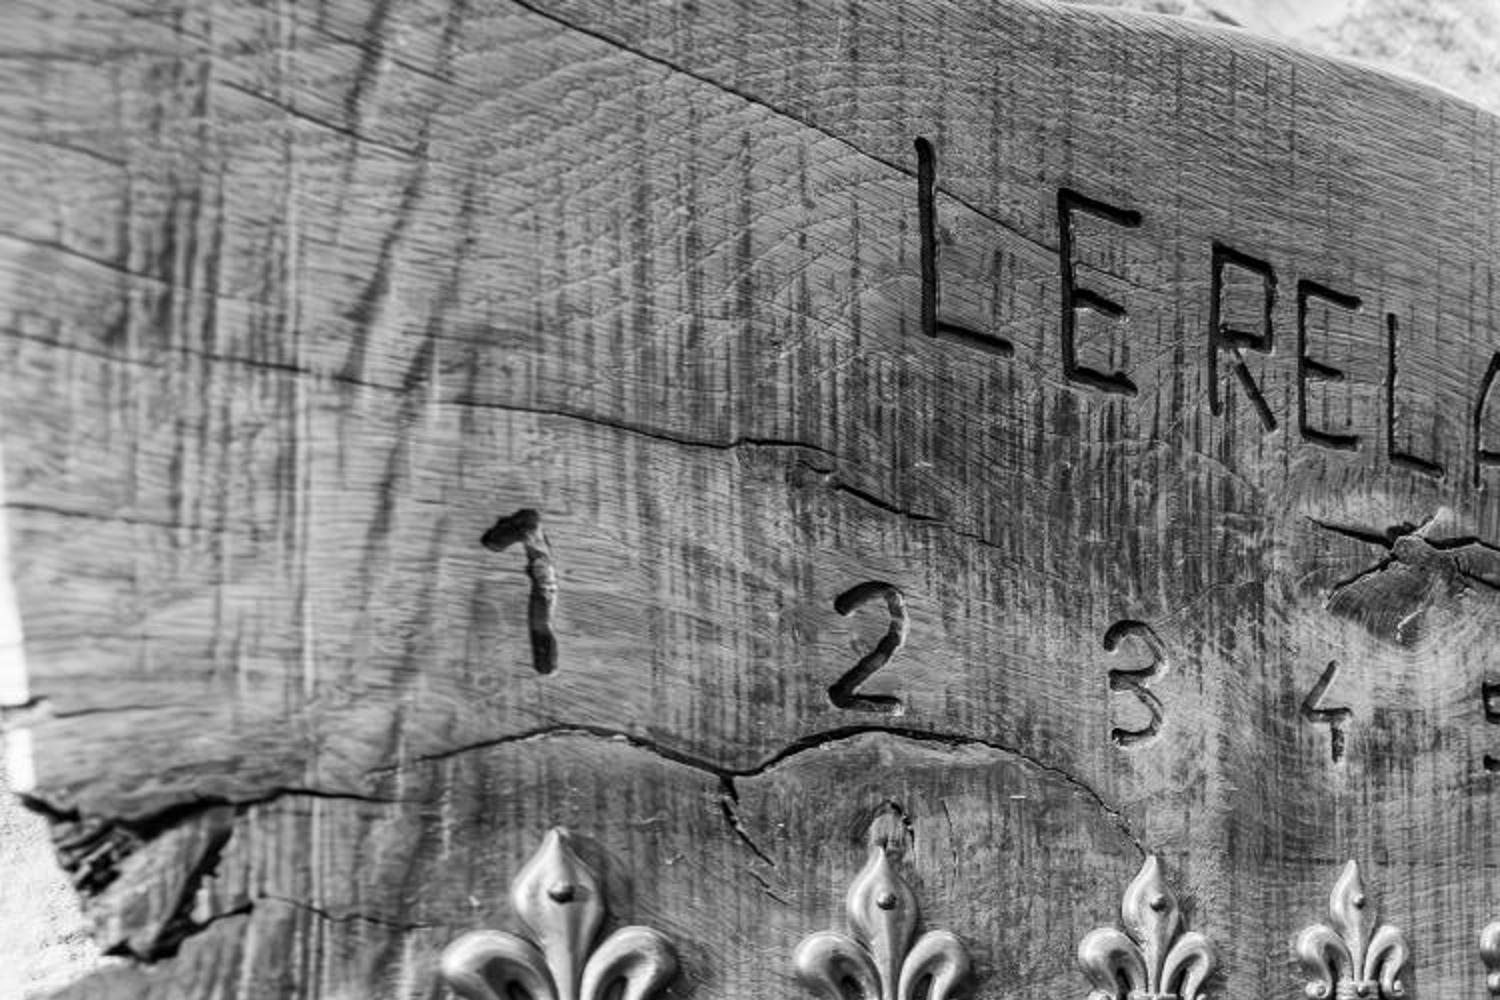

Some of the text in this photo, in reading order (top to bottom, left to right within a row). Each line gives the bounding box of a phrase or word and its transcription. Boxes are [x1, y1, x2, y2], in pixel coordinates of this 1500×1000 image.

[915, 135, 1143, 396] LE
[479, 507, 559, 676] 1
[826, 580, 907, 716] 2
[1102, 617, 1169, 750] 3
[1300, 660, 1354, 765] 4
